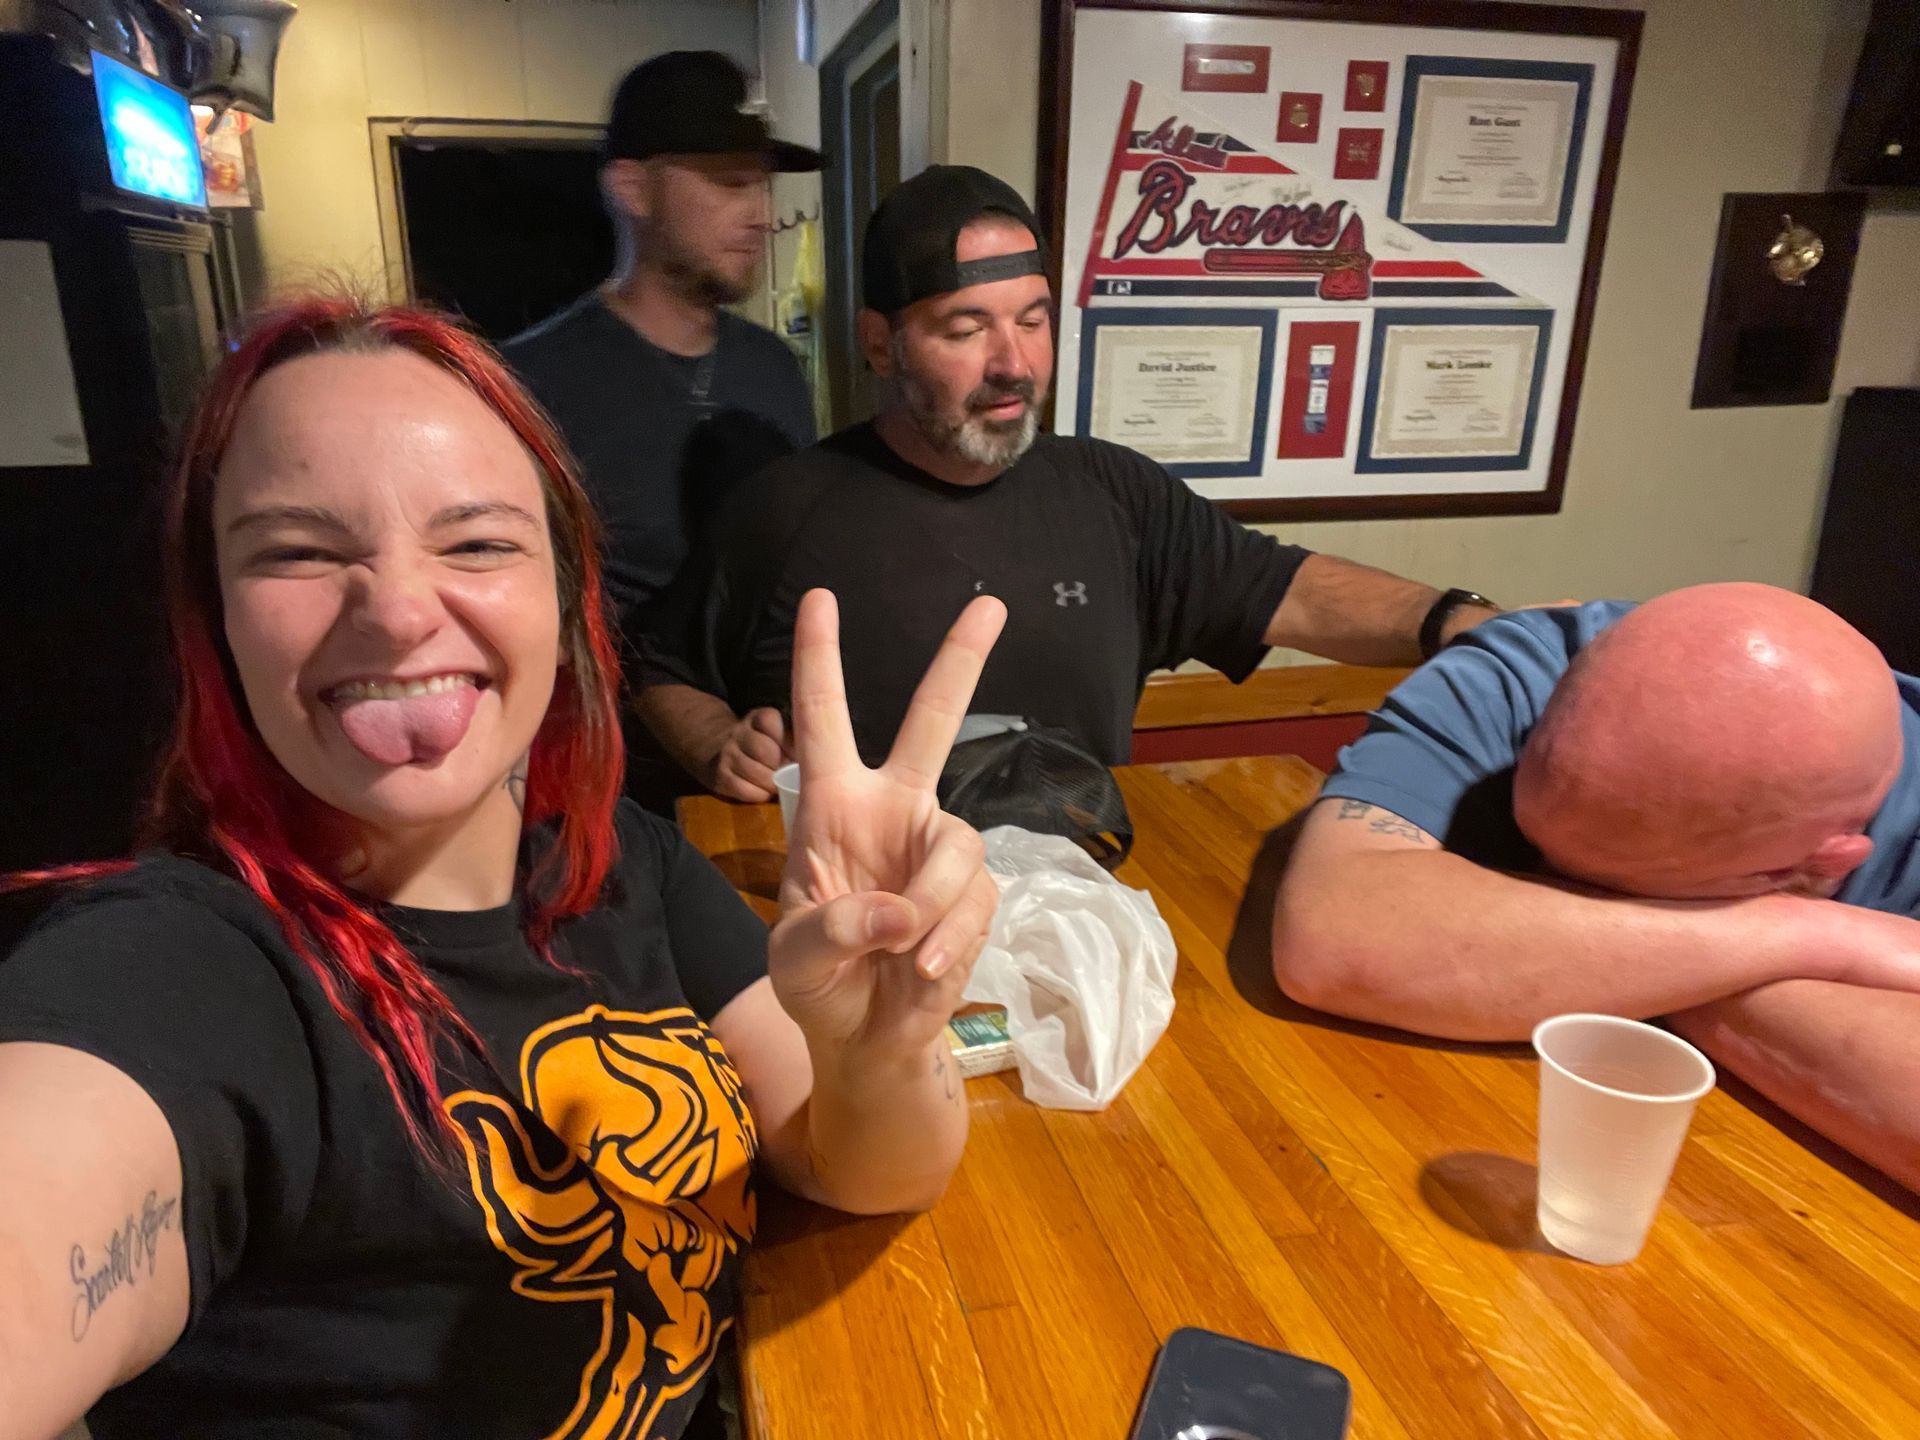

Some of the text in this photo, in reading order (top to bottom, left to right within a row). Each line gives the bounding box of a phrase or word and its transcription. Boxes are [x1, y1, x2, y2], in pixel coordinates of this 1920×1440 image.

[1113, 160, 1348, 260] Braves
[1138, 362, 1217, 372] David Justice
